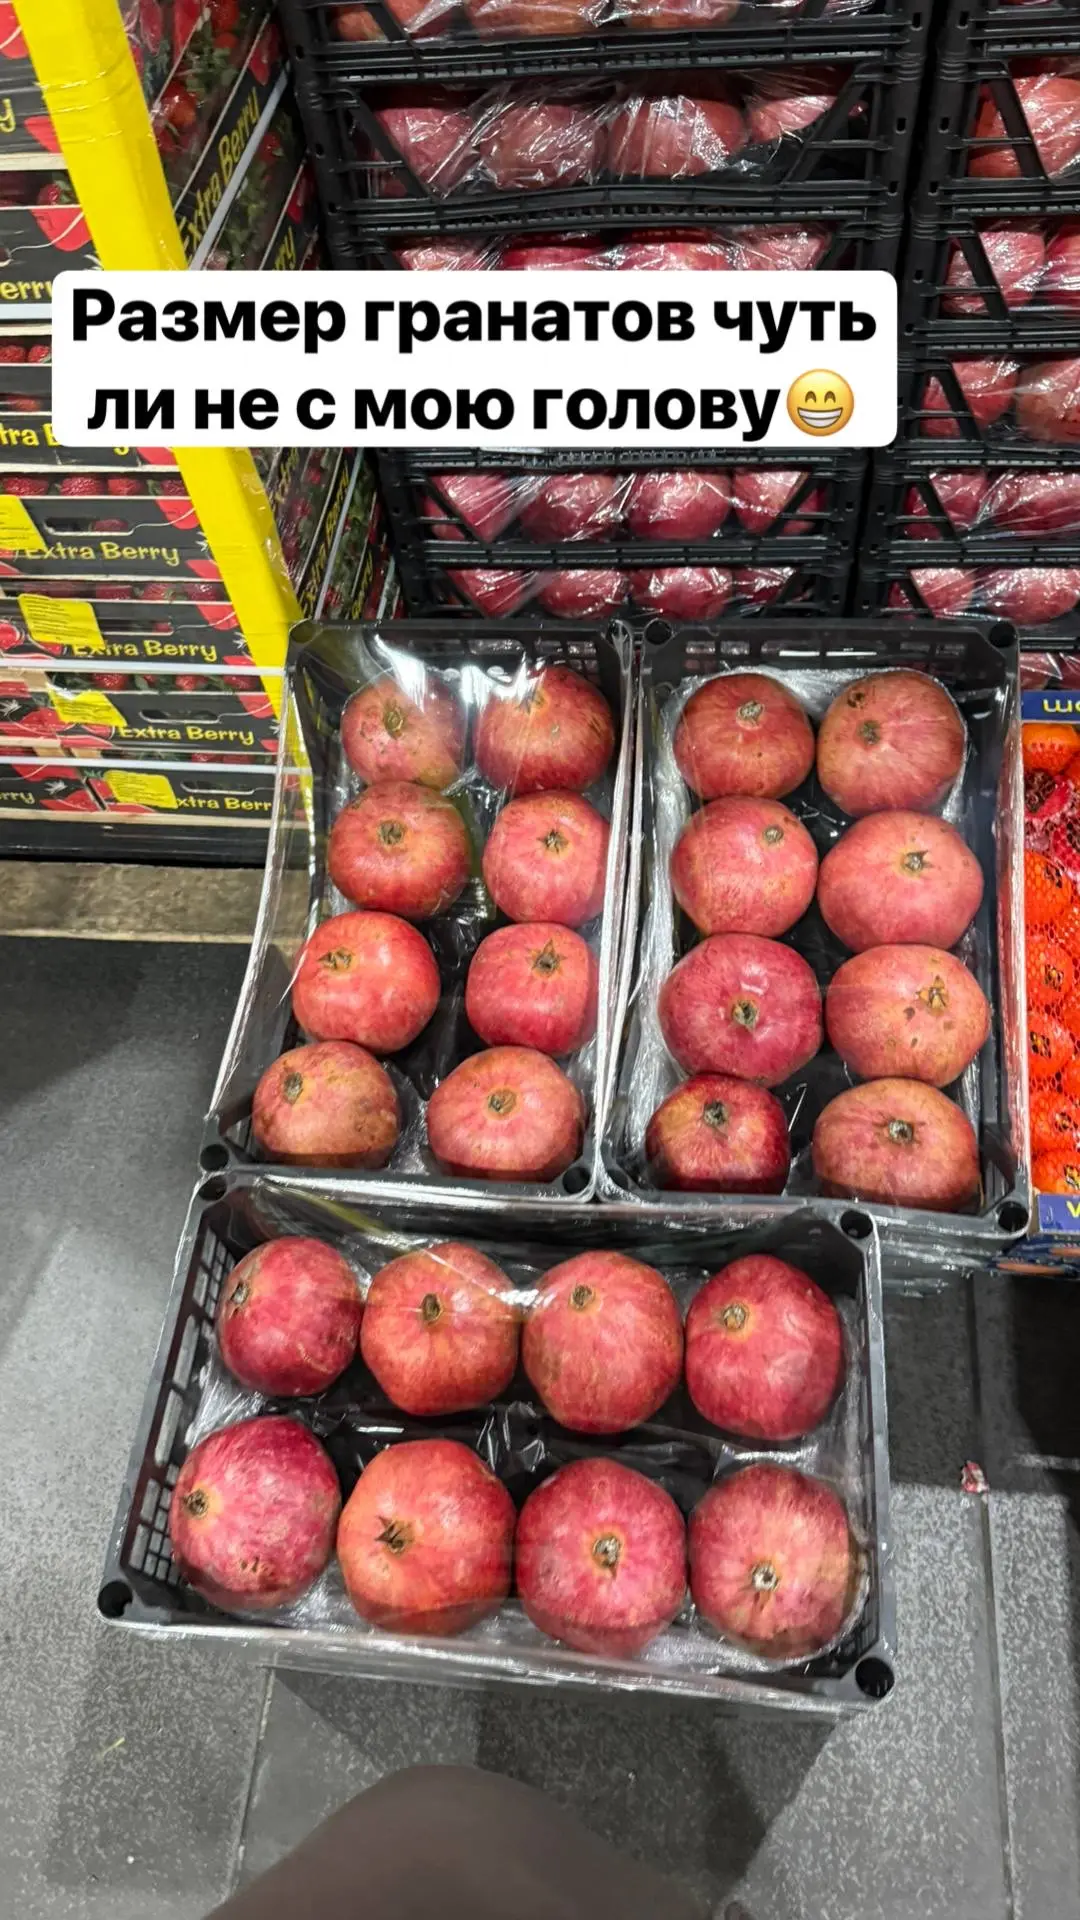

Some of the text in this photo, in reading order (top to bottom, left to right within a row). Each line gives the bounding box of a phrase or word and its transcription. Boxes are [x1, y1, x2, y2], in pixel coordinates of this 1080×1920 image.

[0, 280, 52, 300] err
[100, 541, 180, 567] Berry
[143, 639, 217, 662] Berry
[119, 725, 254, 745] Extra Berry
[176, 796, 273, 811] xtra Berr
